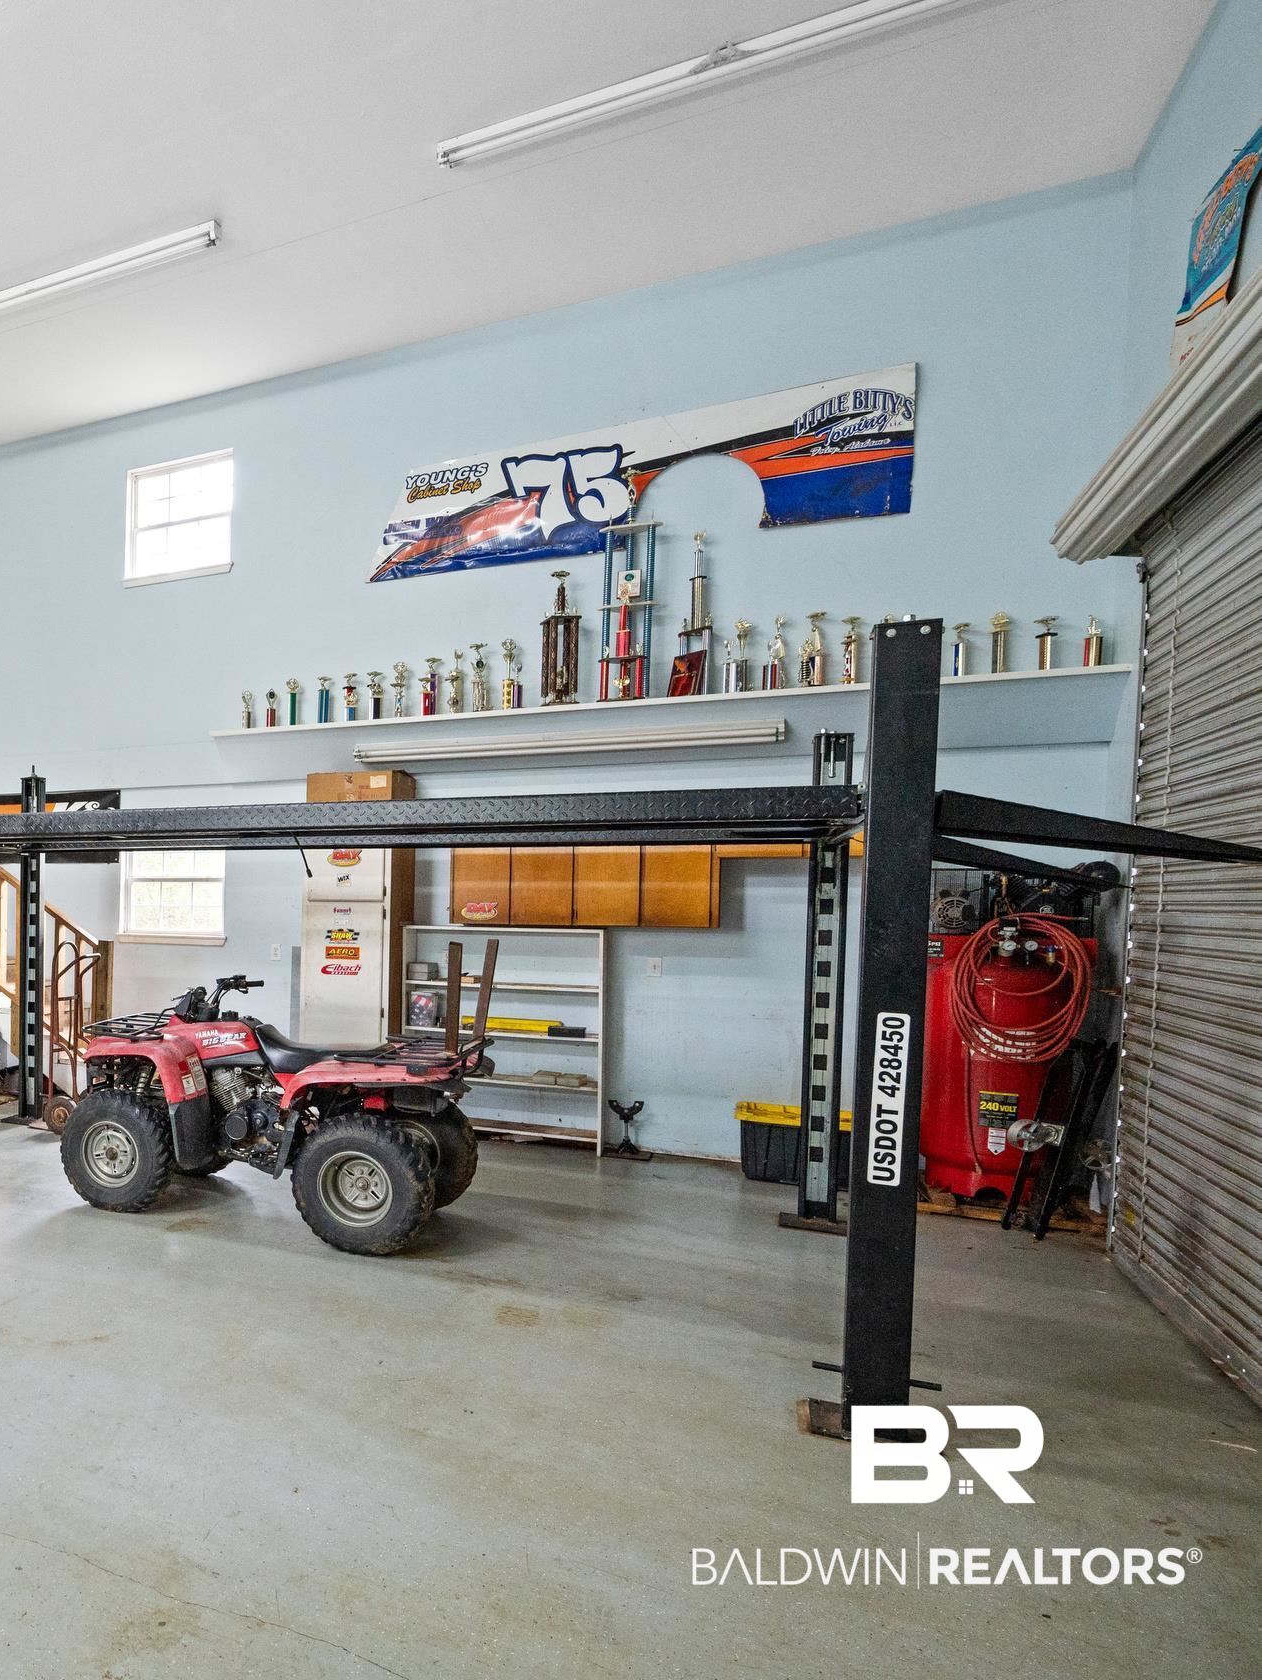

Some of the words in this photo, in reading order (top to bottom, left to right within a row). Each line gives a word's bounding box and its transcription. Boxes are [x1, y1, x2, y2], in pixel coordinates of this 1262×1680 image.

[793, 391, 850, 439] LITTLE
[852, 387, 916, 422] BITTY'S
[814, 413, 894, 446] Towing
[405, 462, 489, 490] YOUNG'S
[406, 483, 451, 504] Cabinet
[450, 477, 483, 495] Shop
[500, 443, 632, 542] 75
[338, 874, 350, 883] WIX
[328, 948, 355, 956] AERO
[320, 963, 362, 975] Eibach
[194, 1029, 219, 1039] YAMAHA
[877, 1016, 906, 1098] 428450
[979, 1101, 1000, 1112] 240
[999, 1104, 1018, 1113] VOLT
[872, 1103, 899, 1182] USDOT
